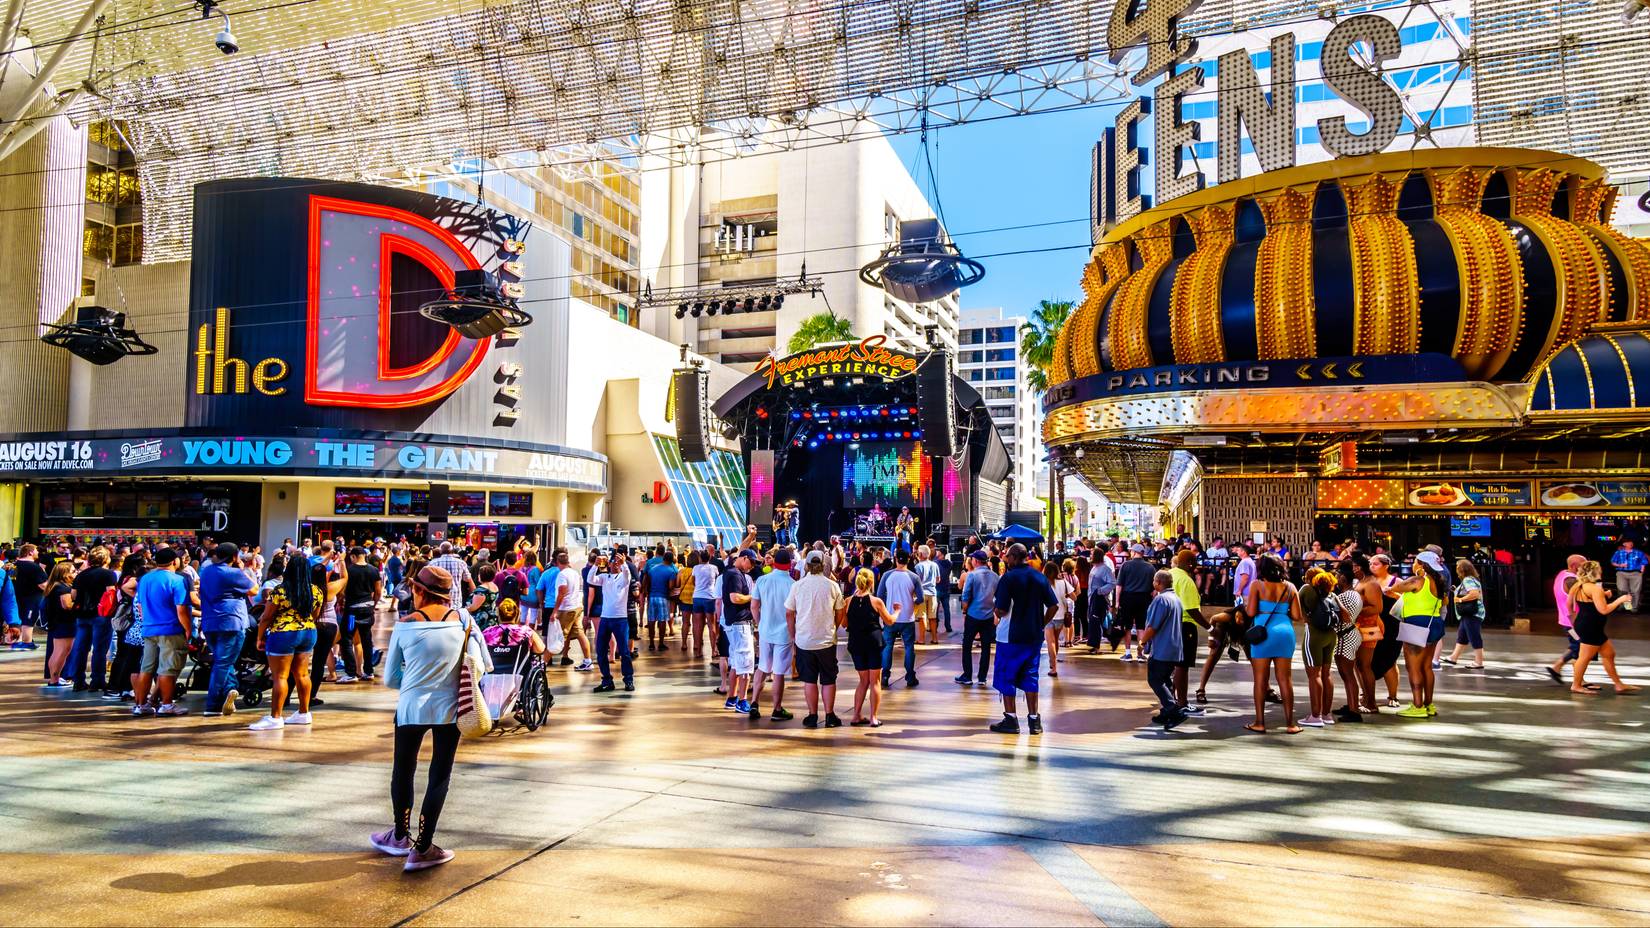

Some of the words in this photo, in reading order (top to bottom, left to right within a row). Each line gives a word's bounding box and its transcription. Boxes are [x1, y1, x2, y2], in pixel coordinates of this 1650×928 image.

[194, 307, 290, 396] the
[304, 194, 493, 409] D
[755, 343, 851, 390] Fremont
[784, 363, 901, 385] EXPERIENCE
[1107, 366, 1270, 391] PARKING
[496, 360, 524, 423] LAS
[0, 441, 67, 461] AUGUST
[72, 441, 92, 460] 16
[183, 440, 293, 465] YOUNG
[315, 442, 375, 467] THE
[398, 445, 498, 473] GIANT
[15, 461, 24, 471] ON
[25, 461, 37, 470] SALE
[39, 460, 53, 470] NOW
[54, 460, 61, 470] AT
[653, 480, 671, 504] D
[214, 510, 228, 531] D
